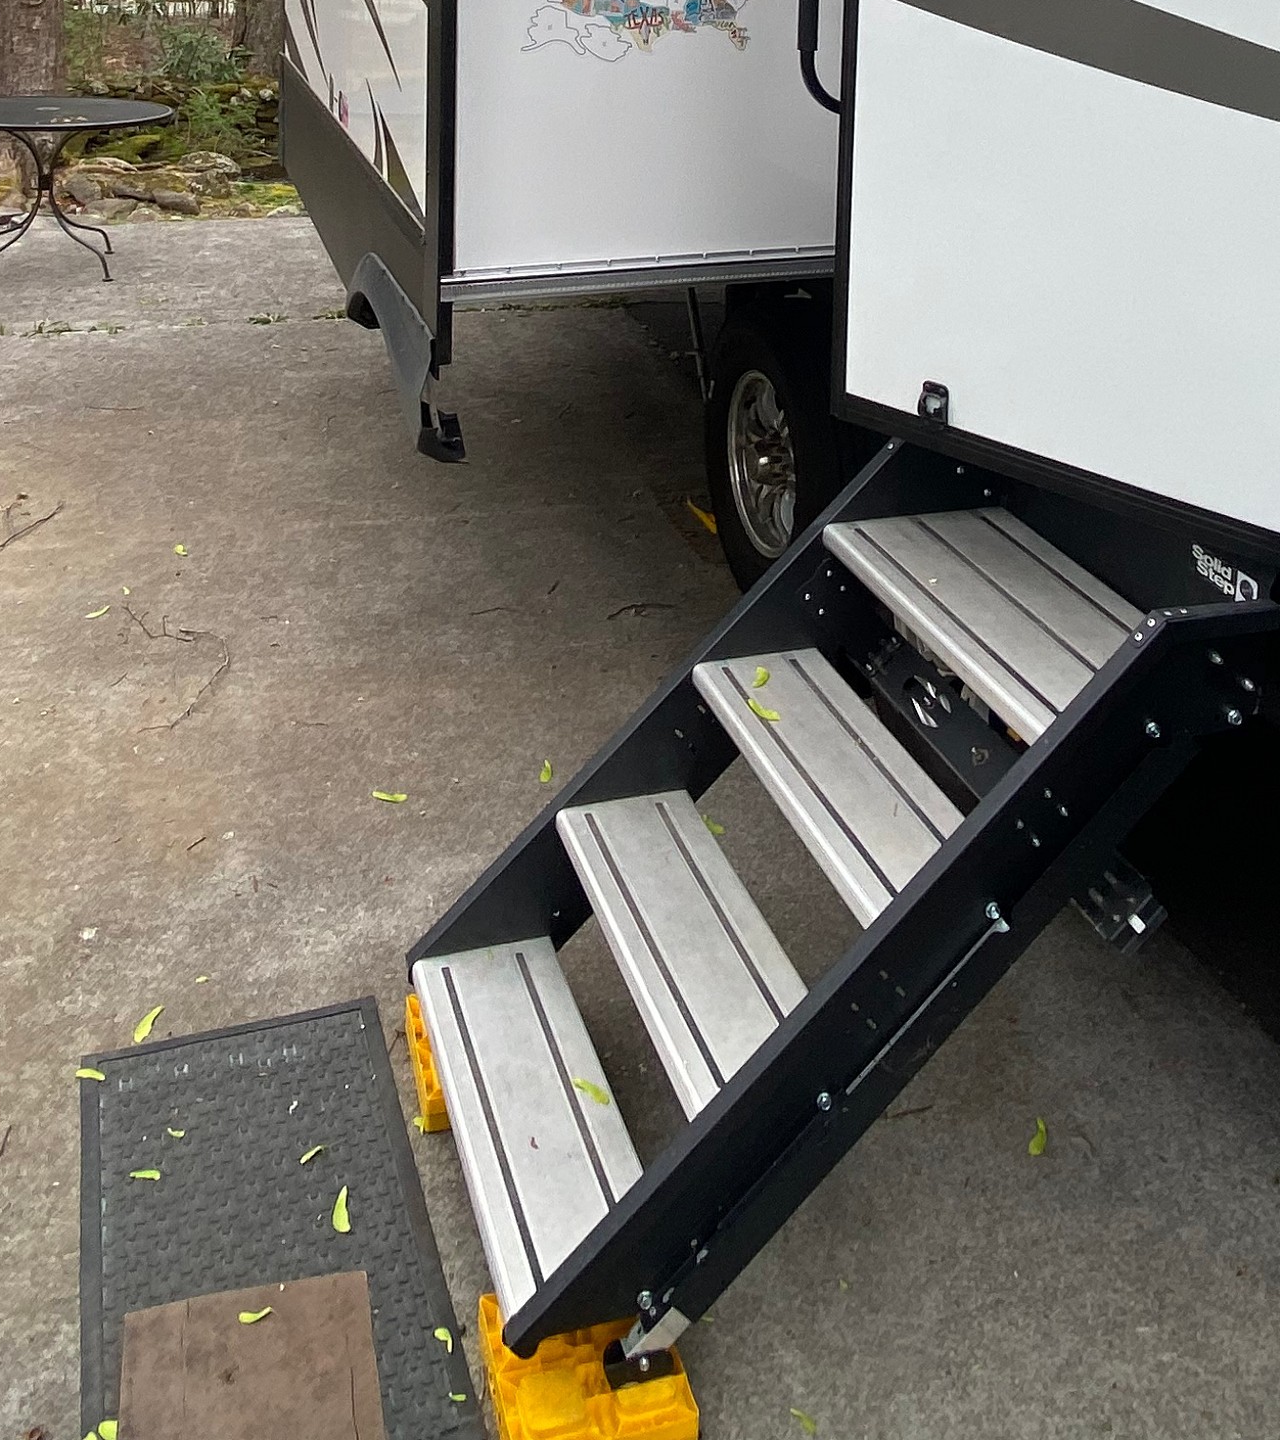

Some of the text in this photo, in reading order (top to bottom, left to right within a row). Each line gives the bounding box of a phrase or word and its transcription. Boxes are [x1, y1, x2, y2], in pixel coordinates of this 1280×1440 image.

[624, 6, 664, 29] TEXAS
[1192, 544, 1232, 580] Solid
[1196, 560, 1235, 596] Step
